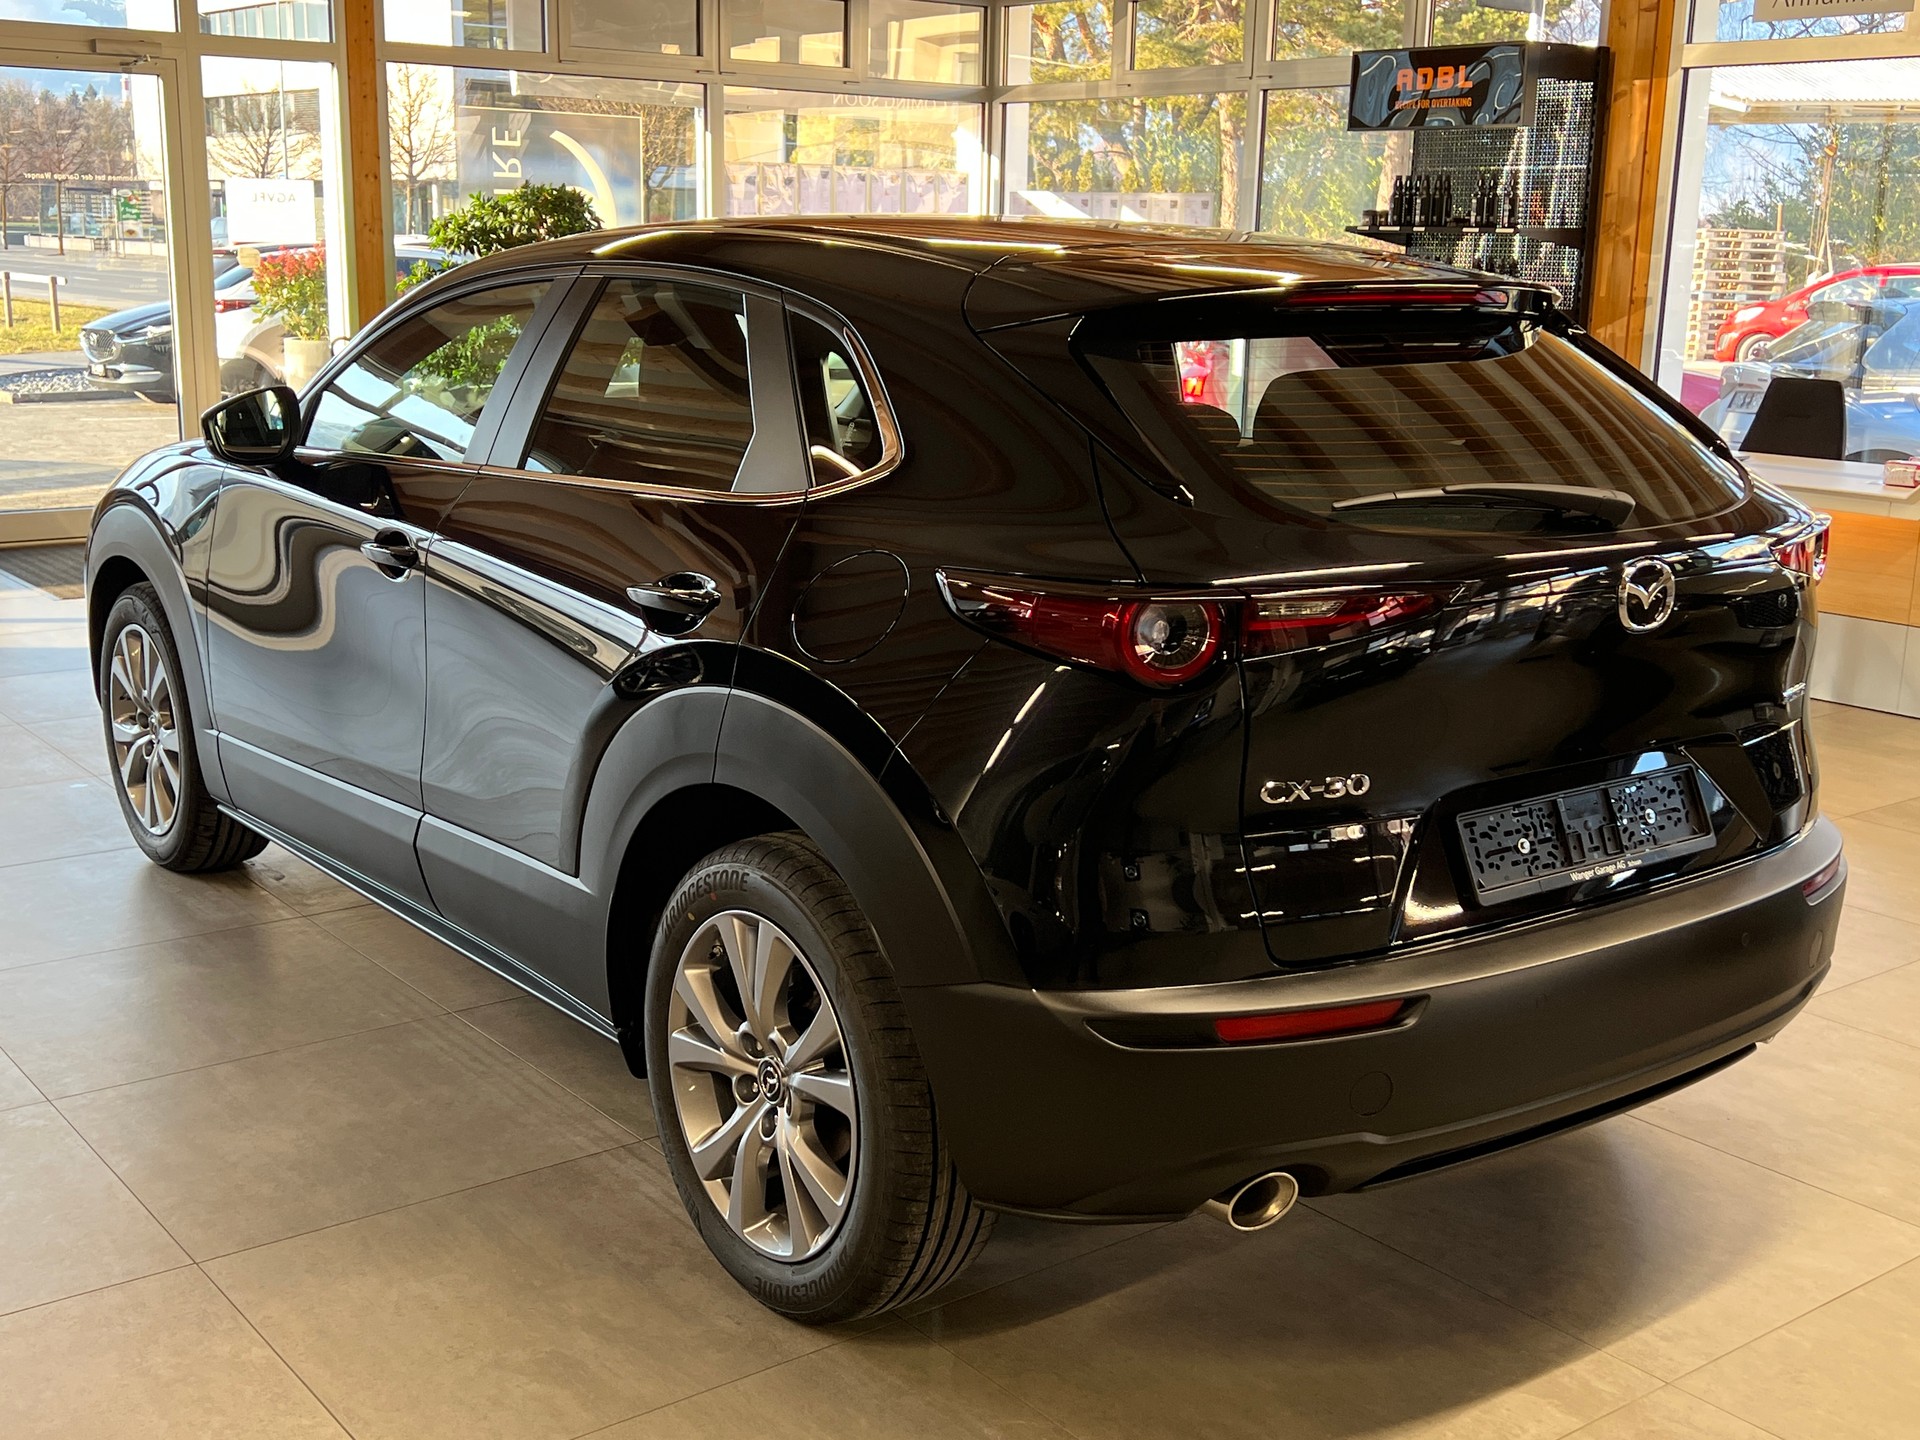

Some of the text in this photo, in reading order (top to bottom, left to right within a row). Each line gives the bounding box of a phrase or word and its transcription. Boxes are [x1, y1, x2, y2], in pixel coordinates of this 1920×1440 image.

[1396, 64, 1473, 92] ADBL
[1418, 99, 1430, 109] FOR
[1431, 97, 1472, 109] OVERTAKING
[1260, 773, 1371, 804] CX-30
[1569, 868, 1595, 882] Wanger
[1594, 864, 1616, 876] Garage
[1616, 860, 1626, 870] AG
